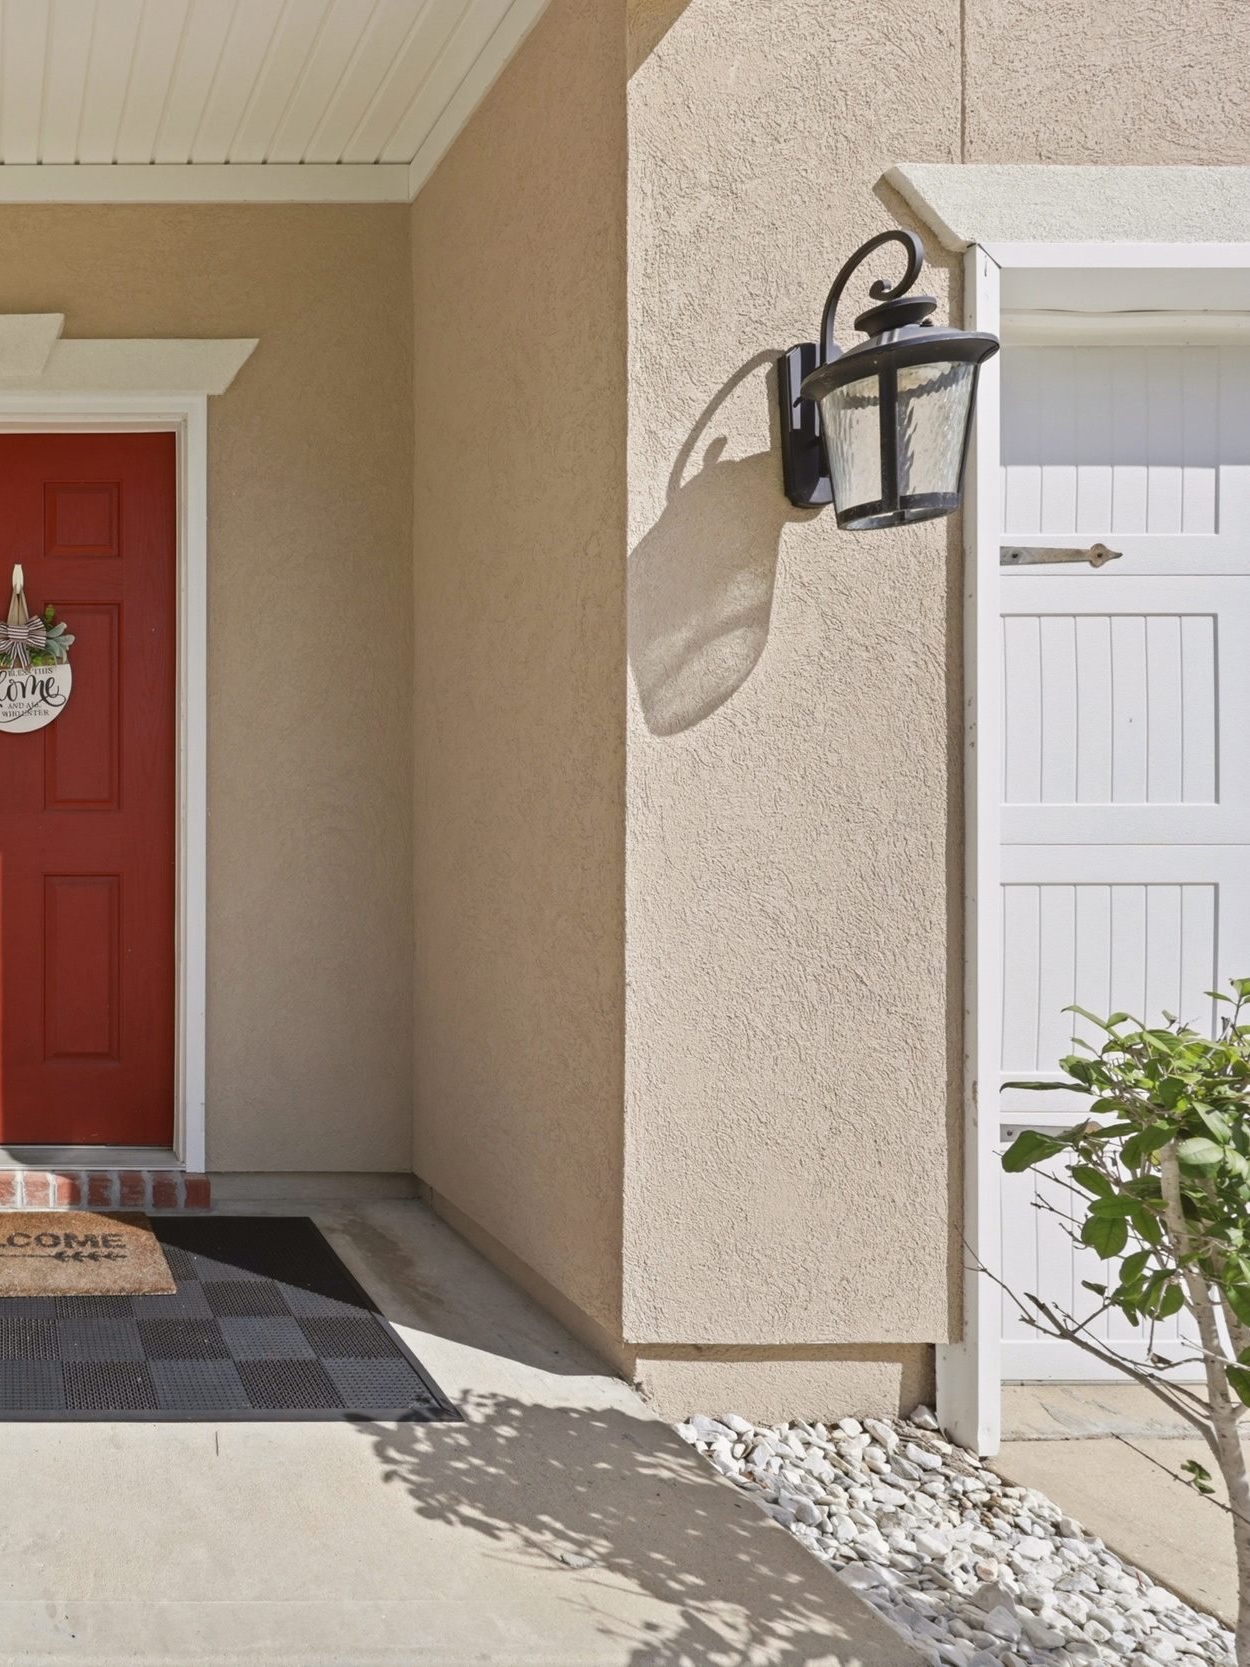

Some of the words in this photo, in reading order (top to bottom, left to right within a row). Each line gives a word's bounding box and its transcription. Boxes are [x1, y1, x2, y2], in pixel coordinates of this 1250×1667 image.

[31, 667, 53, 676] THIS
[26, 701, 42, 709] ALL
[21, 709, 50, 717] ENTER
